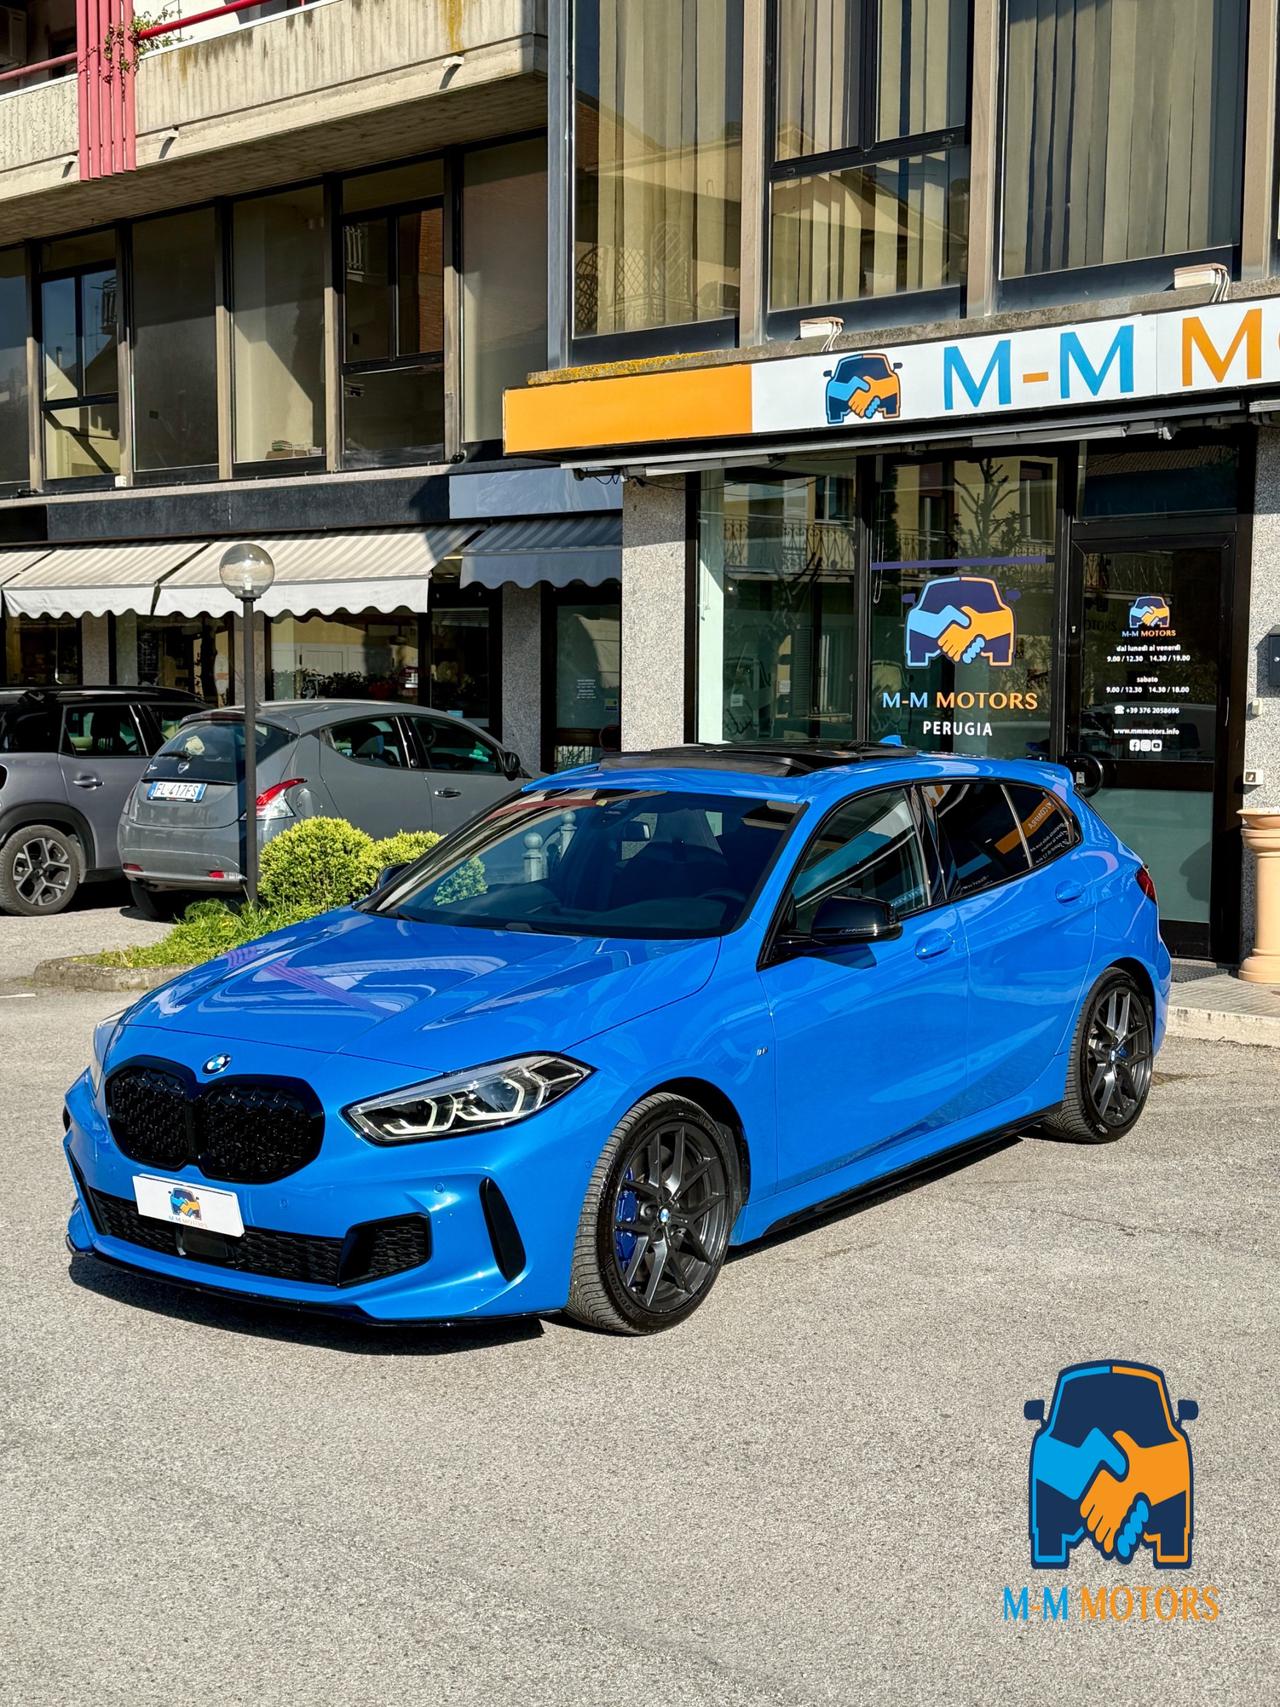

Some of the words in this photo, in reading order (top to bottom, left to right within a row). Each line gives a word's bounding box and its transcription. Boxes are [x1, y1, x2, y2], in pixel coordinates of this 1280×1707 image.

[944, 324, 1134, 410] M-M
[1182, 308, 1280, 388] M
[1141, 629, 1176, 637] MOTORS
[1116, 644, 1127, 652] dal
[1149, 644, 1155, 652] al
[1172, 654, 1191, 662] 19.00
[1136, 675, 1158, 683] sabato
[882, 692, 928, 708] M-M
[936, 691, 1038, 710] MOTORS
[923, 721, 993, 736] PERUGIA
[1113, 727, 1180, 735] www.mmmotors.info
